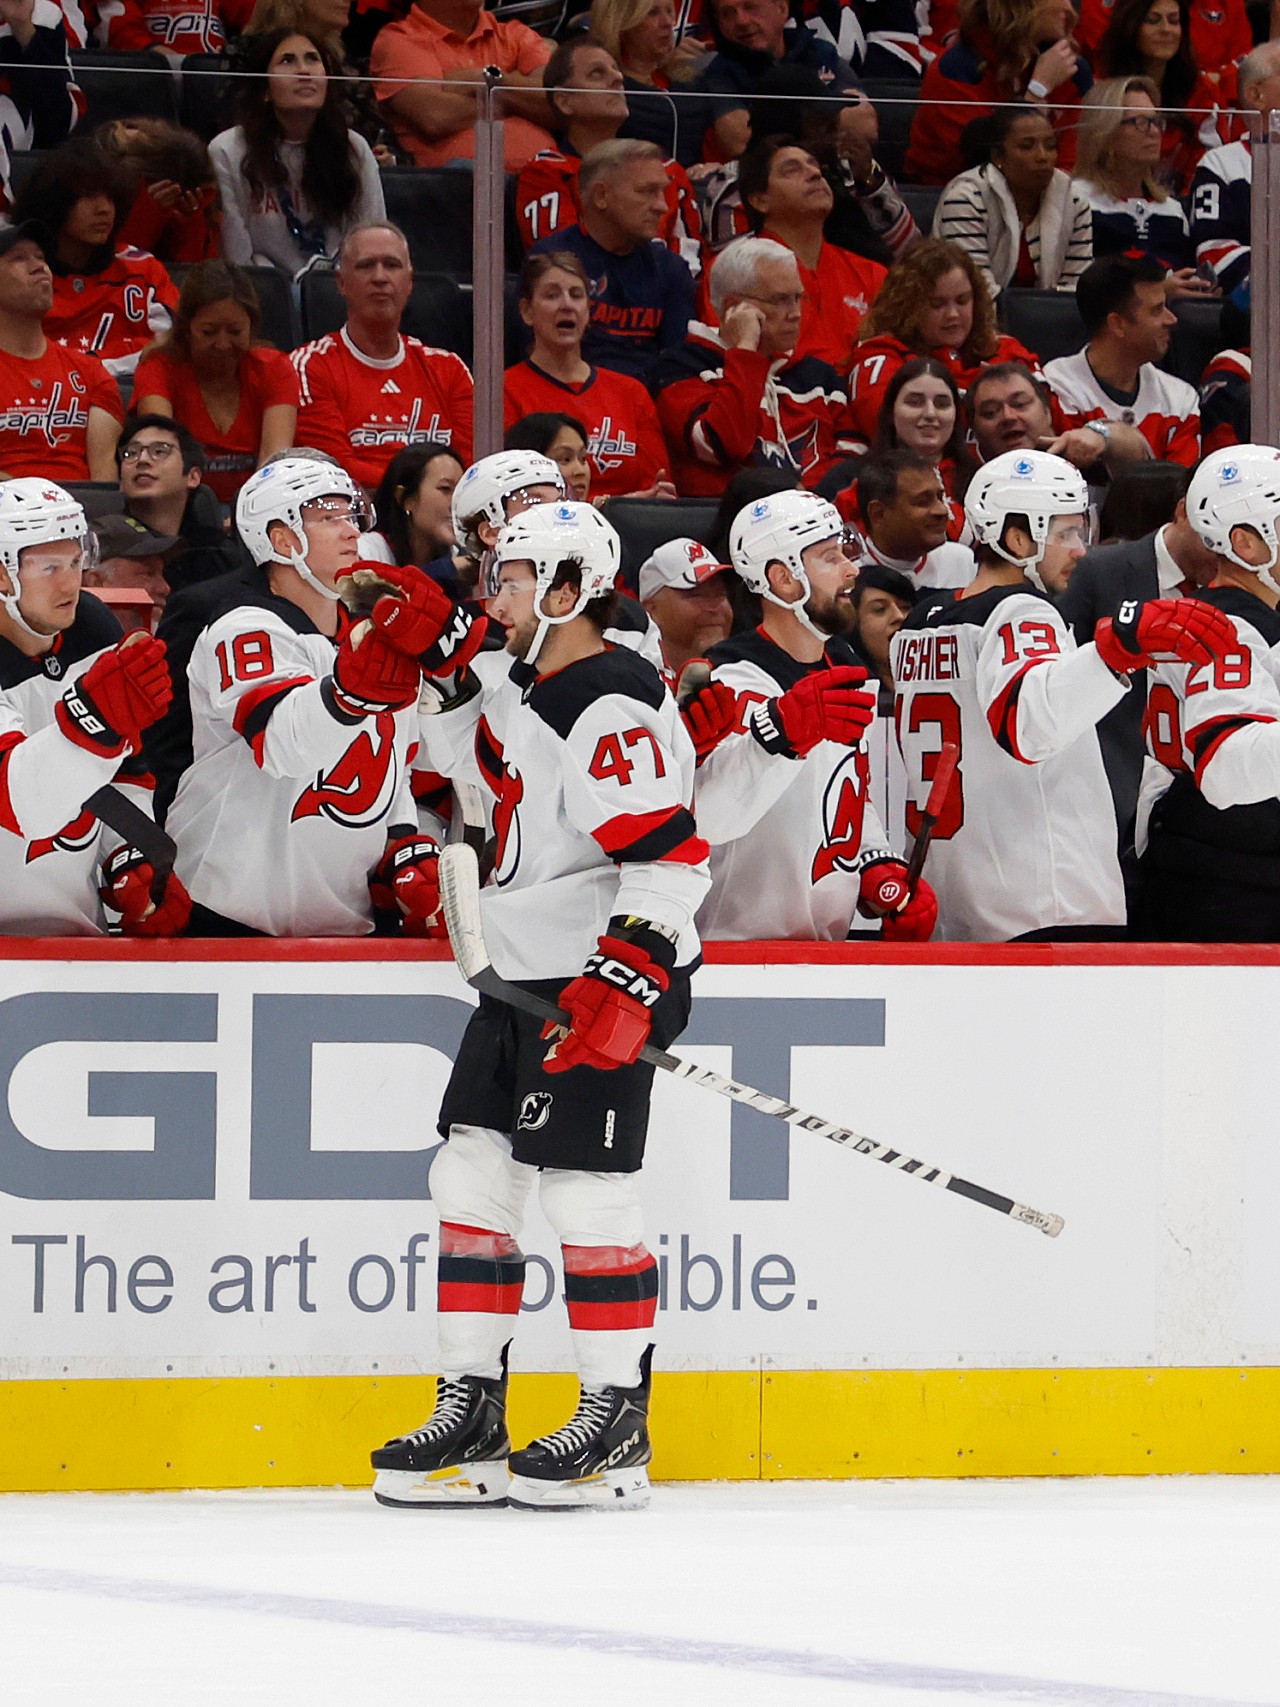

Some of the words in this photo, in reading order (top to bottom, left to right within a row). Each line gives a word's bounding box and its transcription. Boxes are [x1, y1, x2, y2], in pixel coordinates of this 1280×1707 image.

[144, 0, 227, 52] apita
[524, 191, 559, 240] 77
[124, 285, 145, 322] C
[68, 371, 86, 393] C
[586, 416, 637, 475] itals
[215, 630, 275, 692] 18
[998, 621, 1061, 665] 13
[588, 727, 667, 786] 47
[582, 955, 661, 1007] CCM
[603, 1108, 616, 1149] CCM
[11, 1234, 174, 1314] The
[208, 1236, 317, 1314] art
[347, 1234, 429, 1314] of
[463, 1423, 500, 1459] CCM
[592, 1430, 640, 1474] CCM
